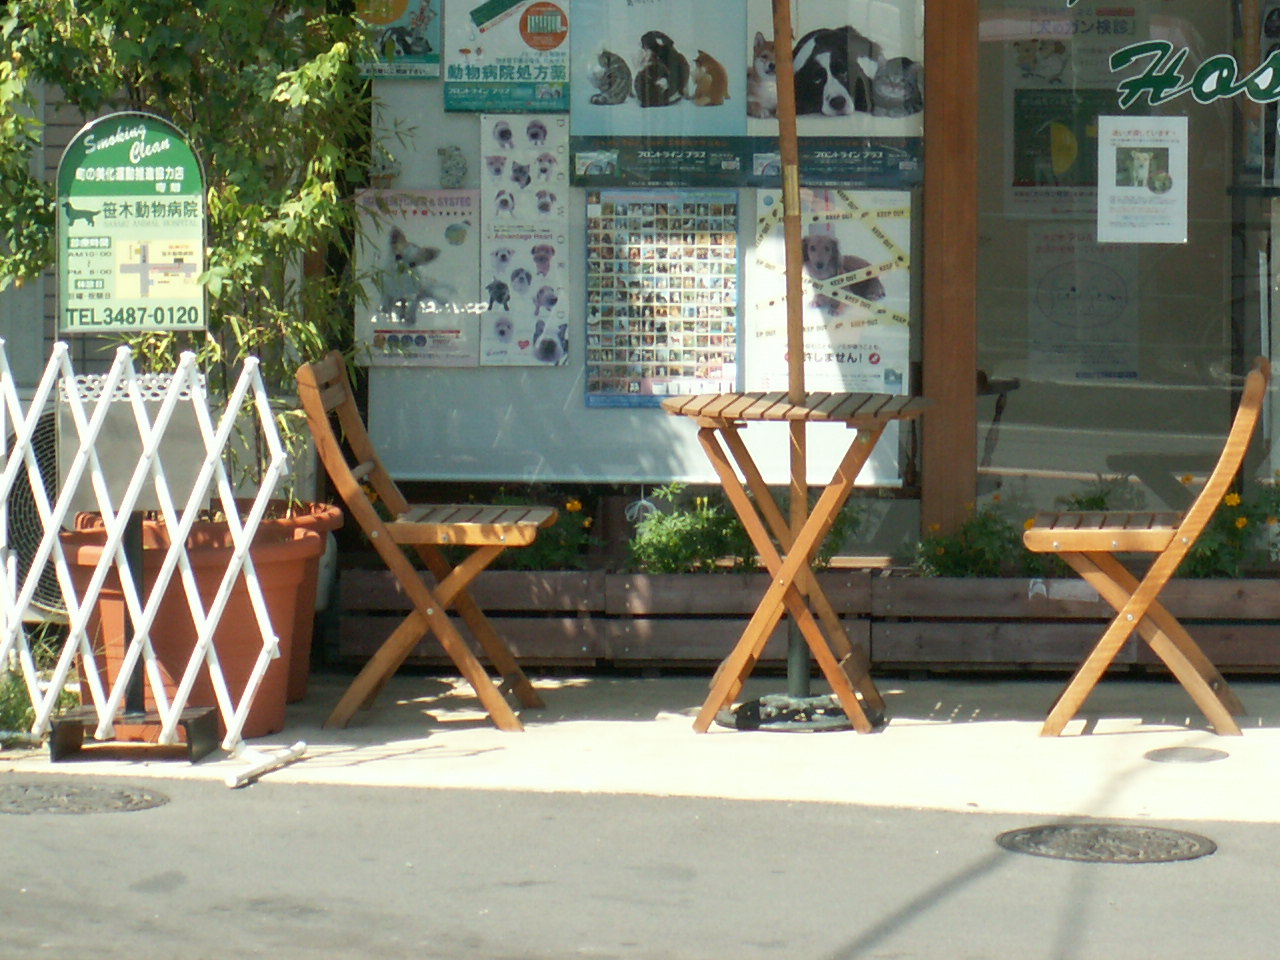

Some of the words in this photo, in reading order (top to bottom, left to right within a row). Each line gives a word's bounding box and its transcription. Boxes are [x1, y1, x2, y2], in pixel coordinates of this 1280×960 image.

[447, 64, 567, 81] 動物病院処方薬
[129, 138, 171, 164] Clean
[102, 201, 199, 220] 笹木動物病院
[65, 307, 199, 326] TEL3487-0120
